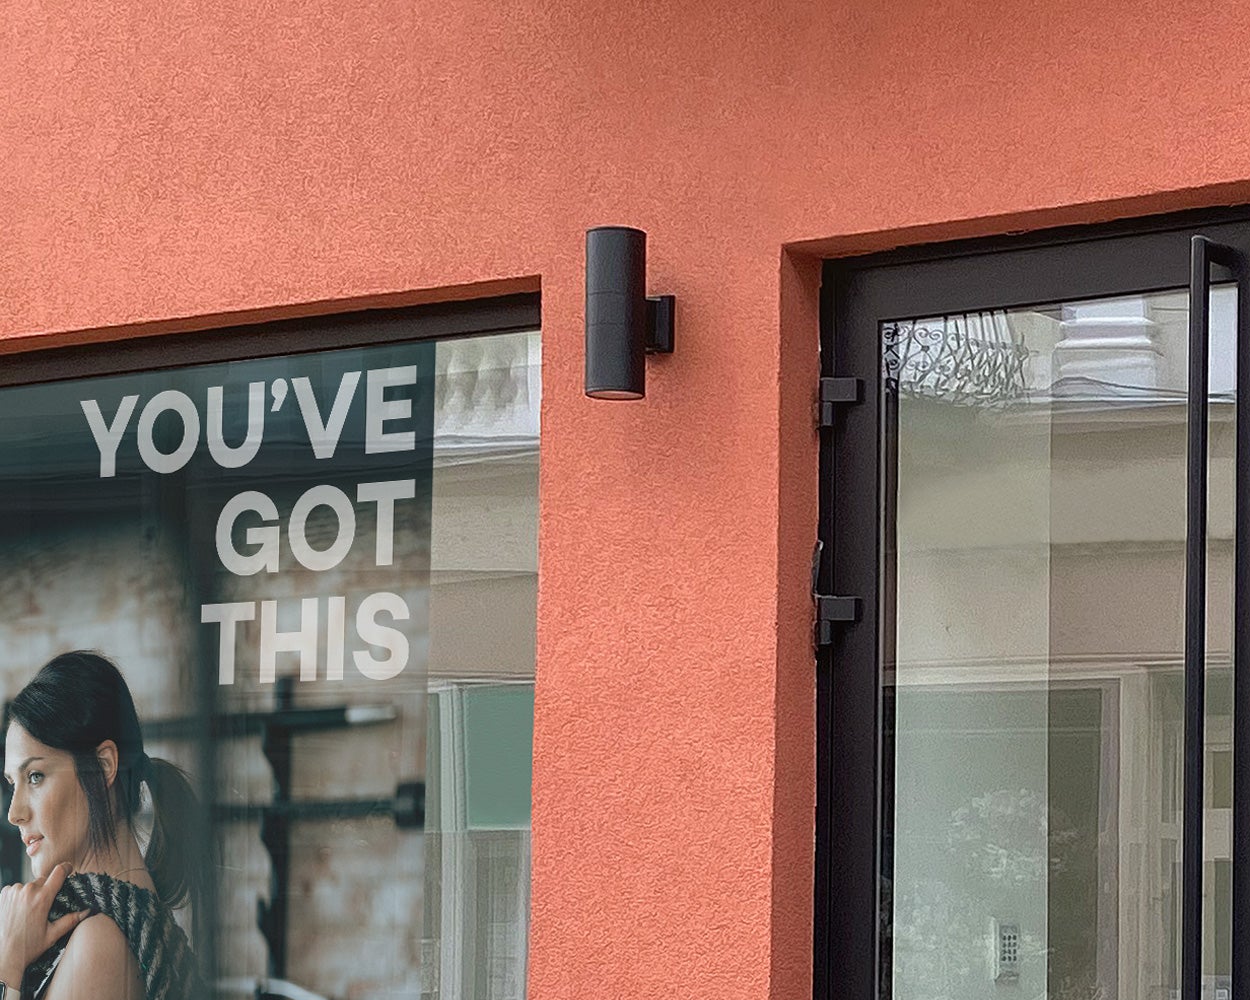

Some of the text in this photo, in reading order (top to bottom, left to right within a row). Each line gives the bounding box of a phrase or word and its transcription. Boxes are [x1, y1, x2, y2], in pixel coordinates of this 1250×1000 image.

[80, 365, 417, 478] YOU'VE
[215, 479, 416, 576] GOT
[201, 592, 410, 686] THIS
